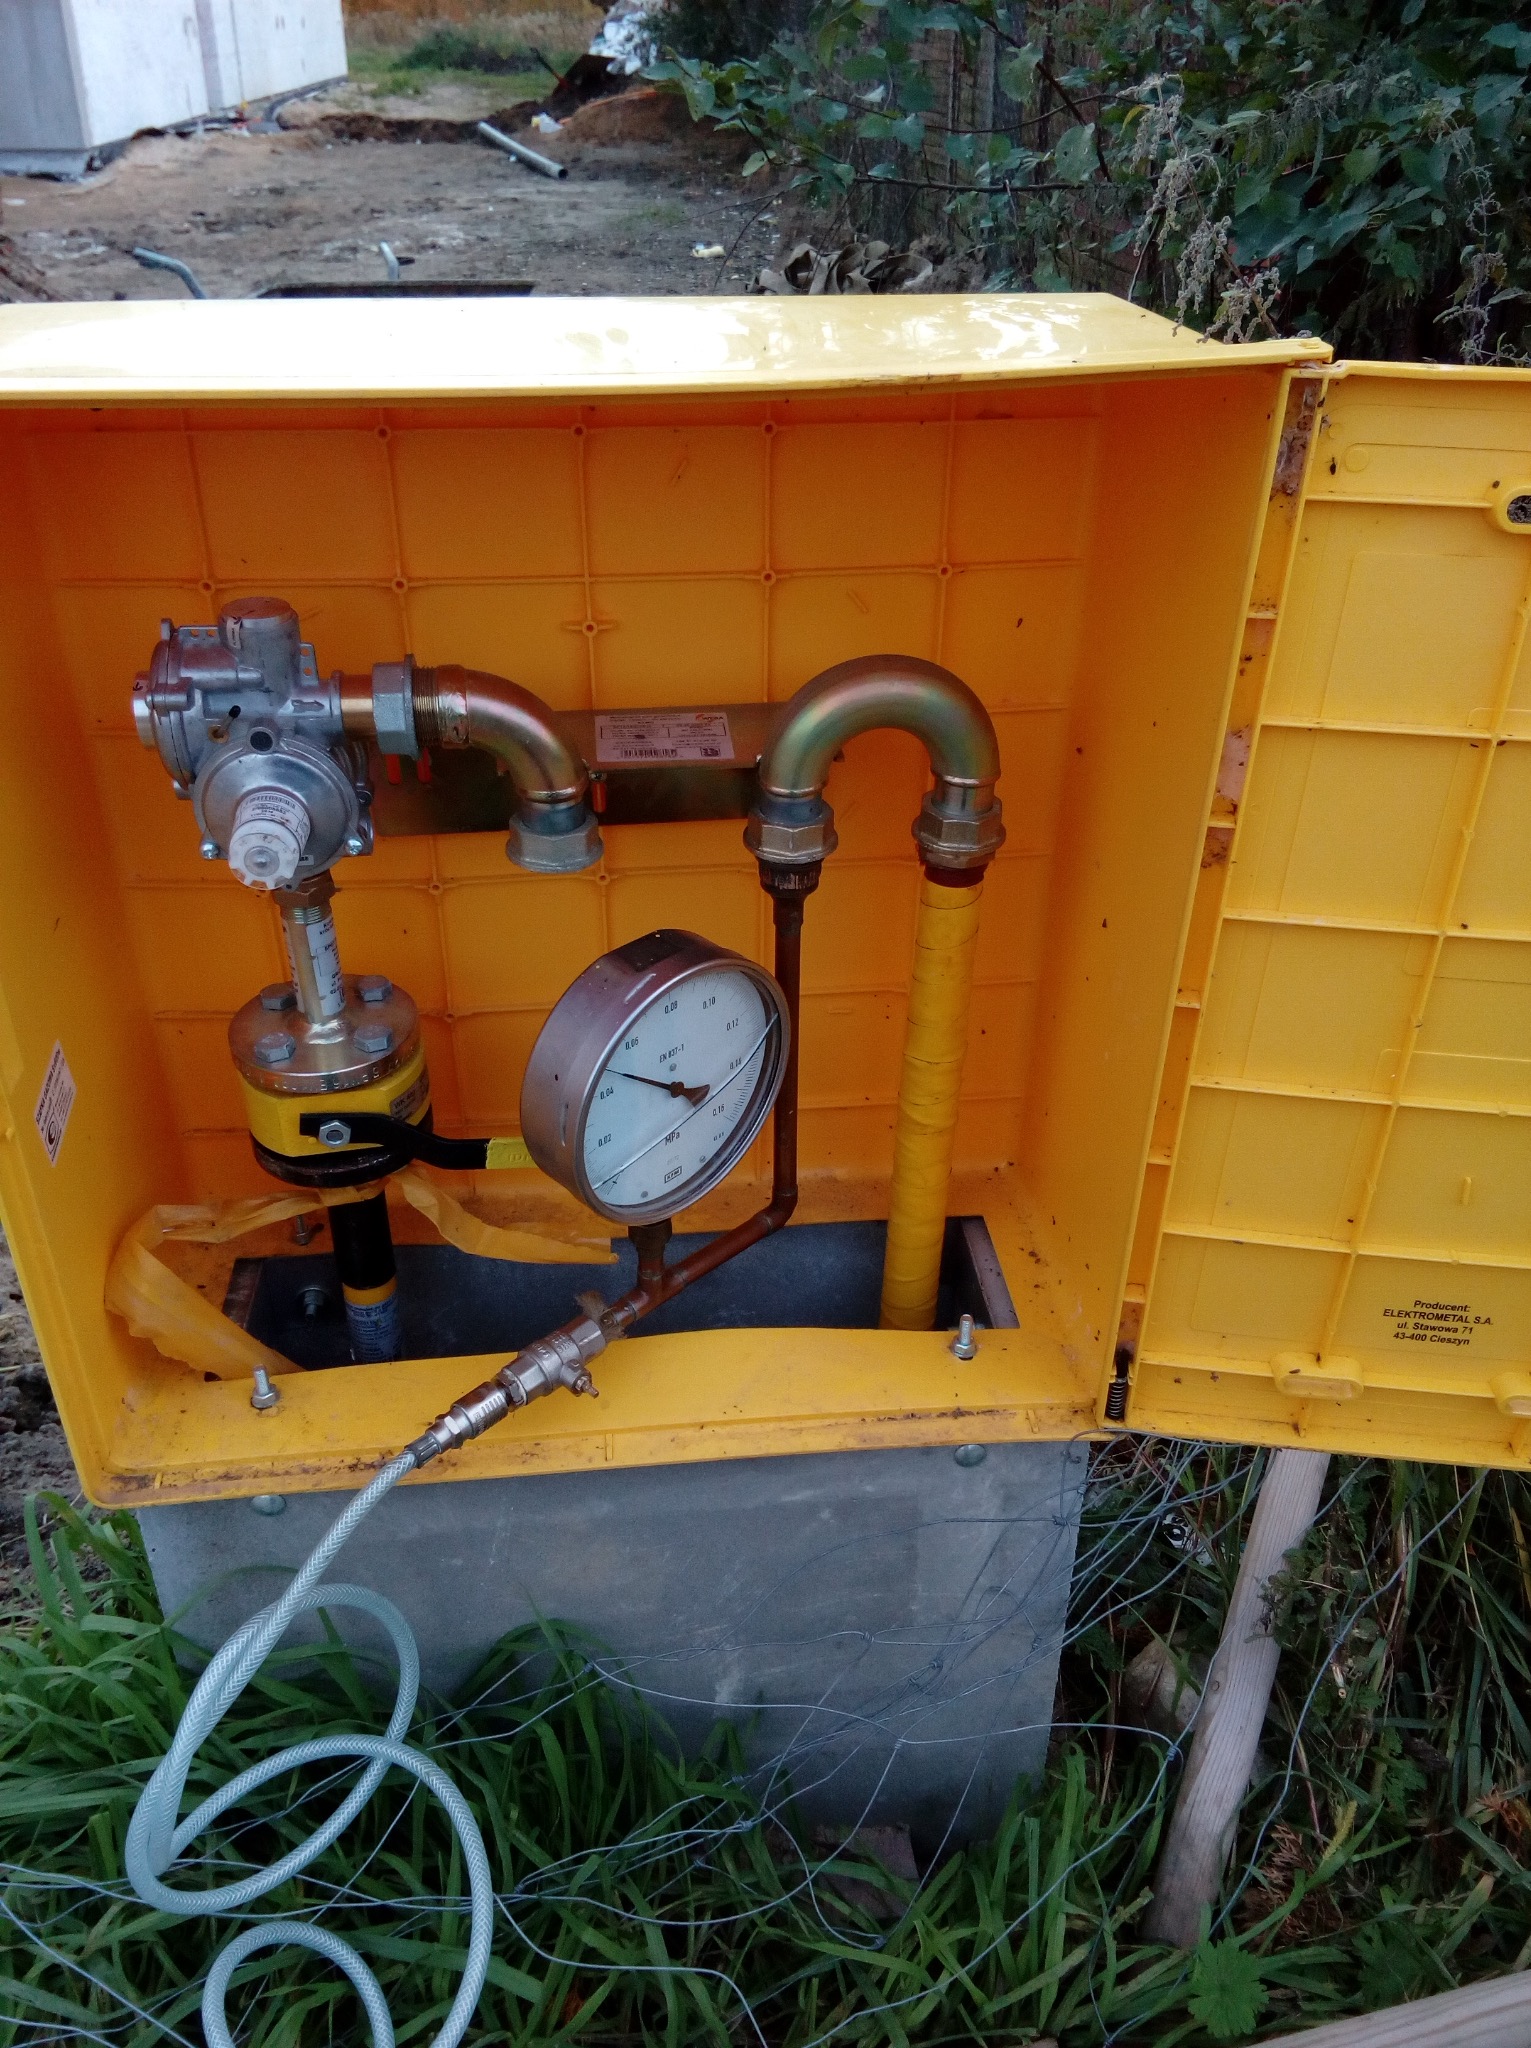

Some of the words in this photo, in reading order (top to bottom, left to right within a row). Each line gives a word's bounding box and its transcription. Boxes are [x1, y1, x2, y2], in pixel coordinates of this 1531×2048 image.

[664, 1001, 678, 1014] 0.08
[703, 997, 716, 1010] 0.10
[726, 1018, 739, 1031] 0.12
[625, 1036, 639, 1050] 0.06
[659, 1053, 667, 1063] EN
[600, 1087, 614, 1100] 0.04
[713, 1104, 725, 1116] 0.16
[598, 1133, 612, 1147] 0.02
[665, 1131, 680, 1145] MPa
[1413, 1300, 1471, 1313] Producent:
[1382, 1308, 1470, 1324] ELEKTROMETAL
[1473, 1316, 1494, 1325] S.A.
[1397, 1321, 1409, 1330] ul.
[1412, 1322, 1459, 1334] Stawowa
[1461, 1326, 1474, 1335] 71
[1393, 1331, 1428, 1342] 43-400
[1429, 1334, 1471, 1347] Cieszyn
